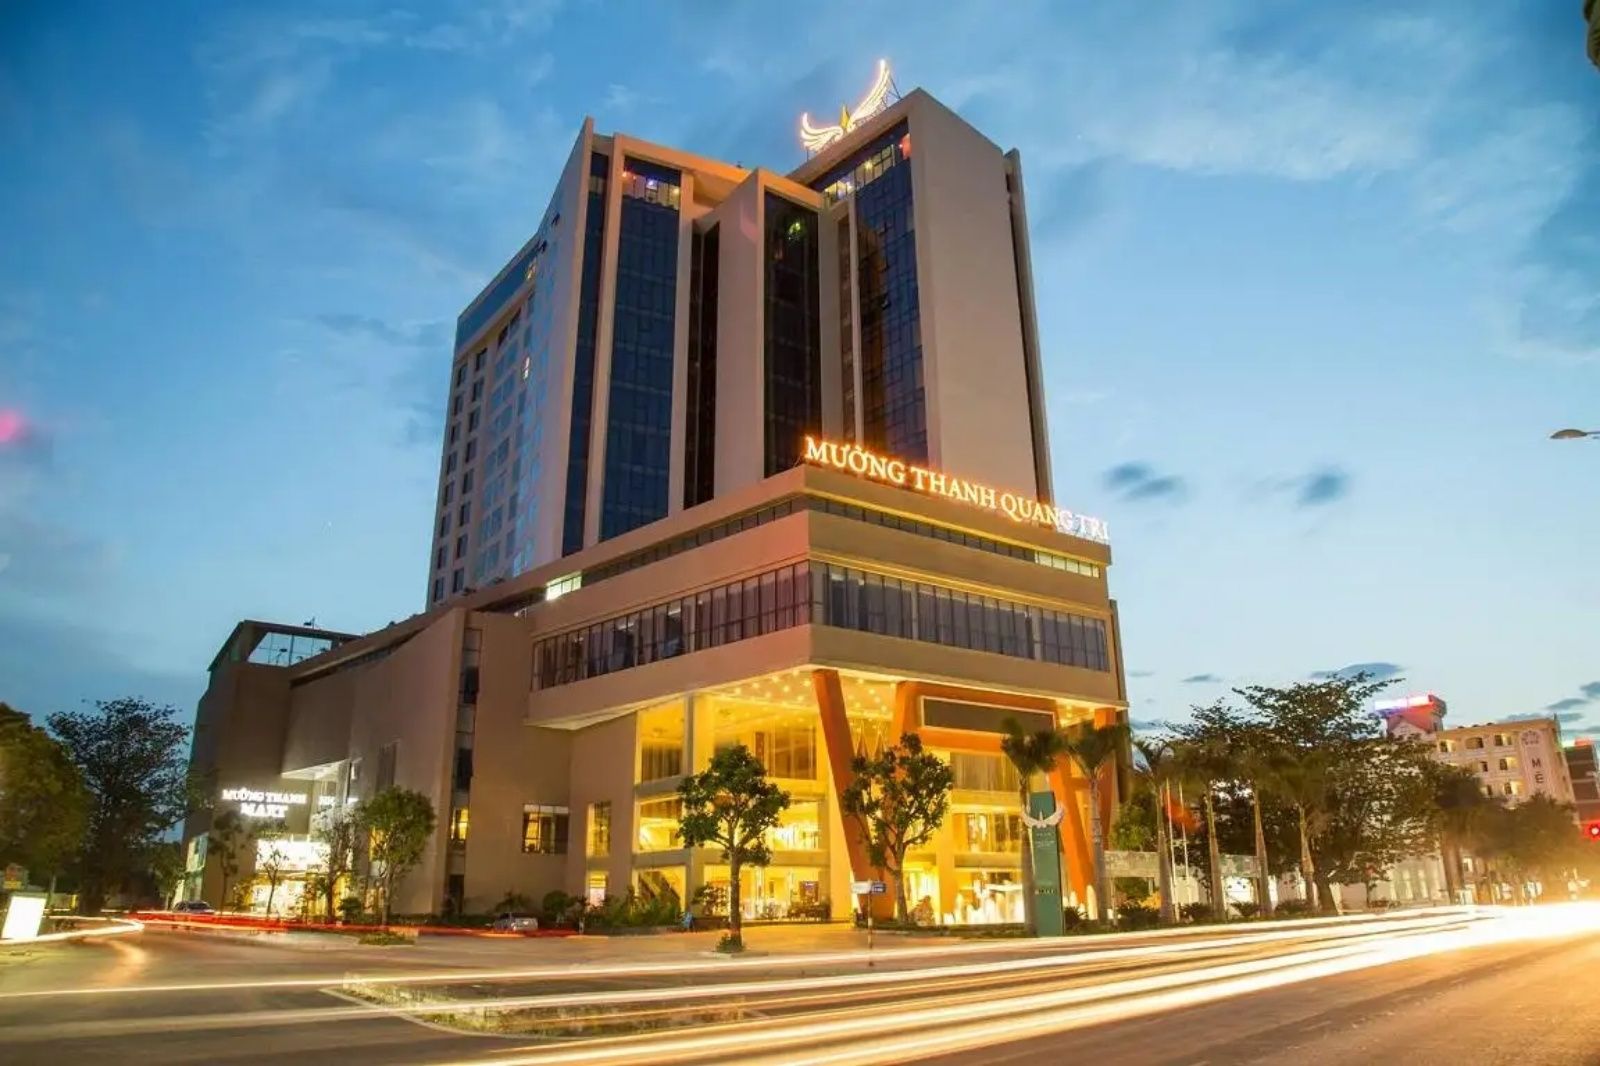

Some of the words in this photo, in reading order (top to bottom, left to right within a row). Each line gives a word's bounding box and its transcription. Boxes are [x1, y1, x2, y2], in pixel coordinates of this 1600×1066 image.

[804, 436, 906, 484] MƯỜNG
[910, 466, 997, 510] THANH
[1000, 493, 1073, 531] QUANG
